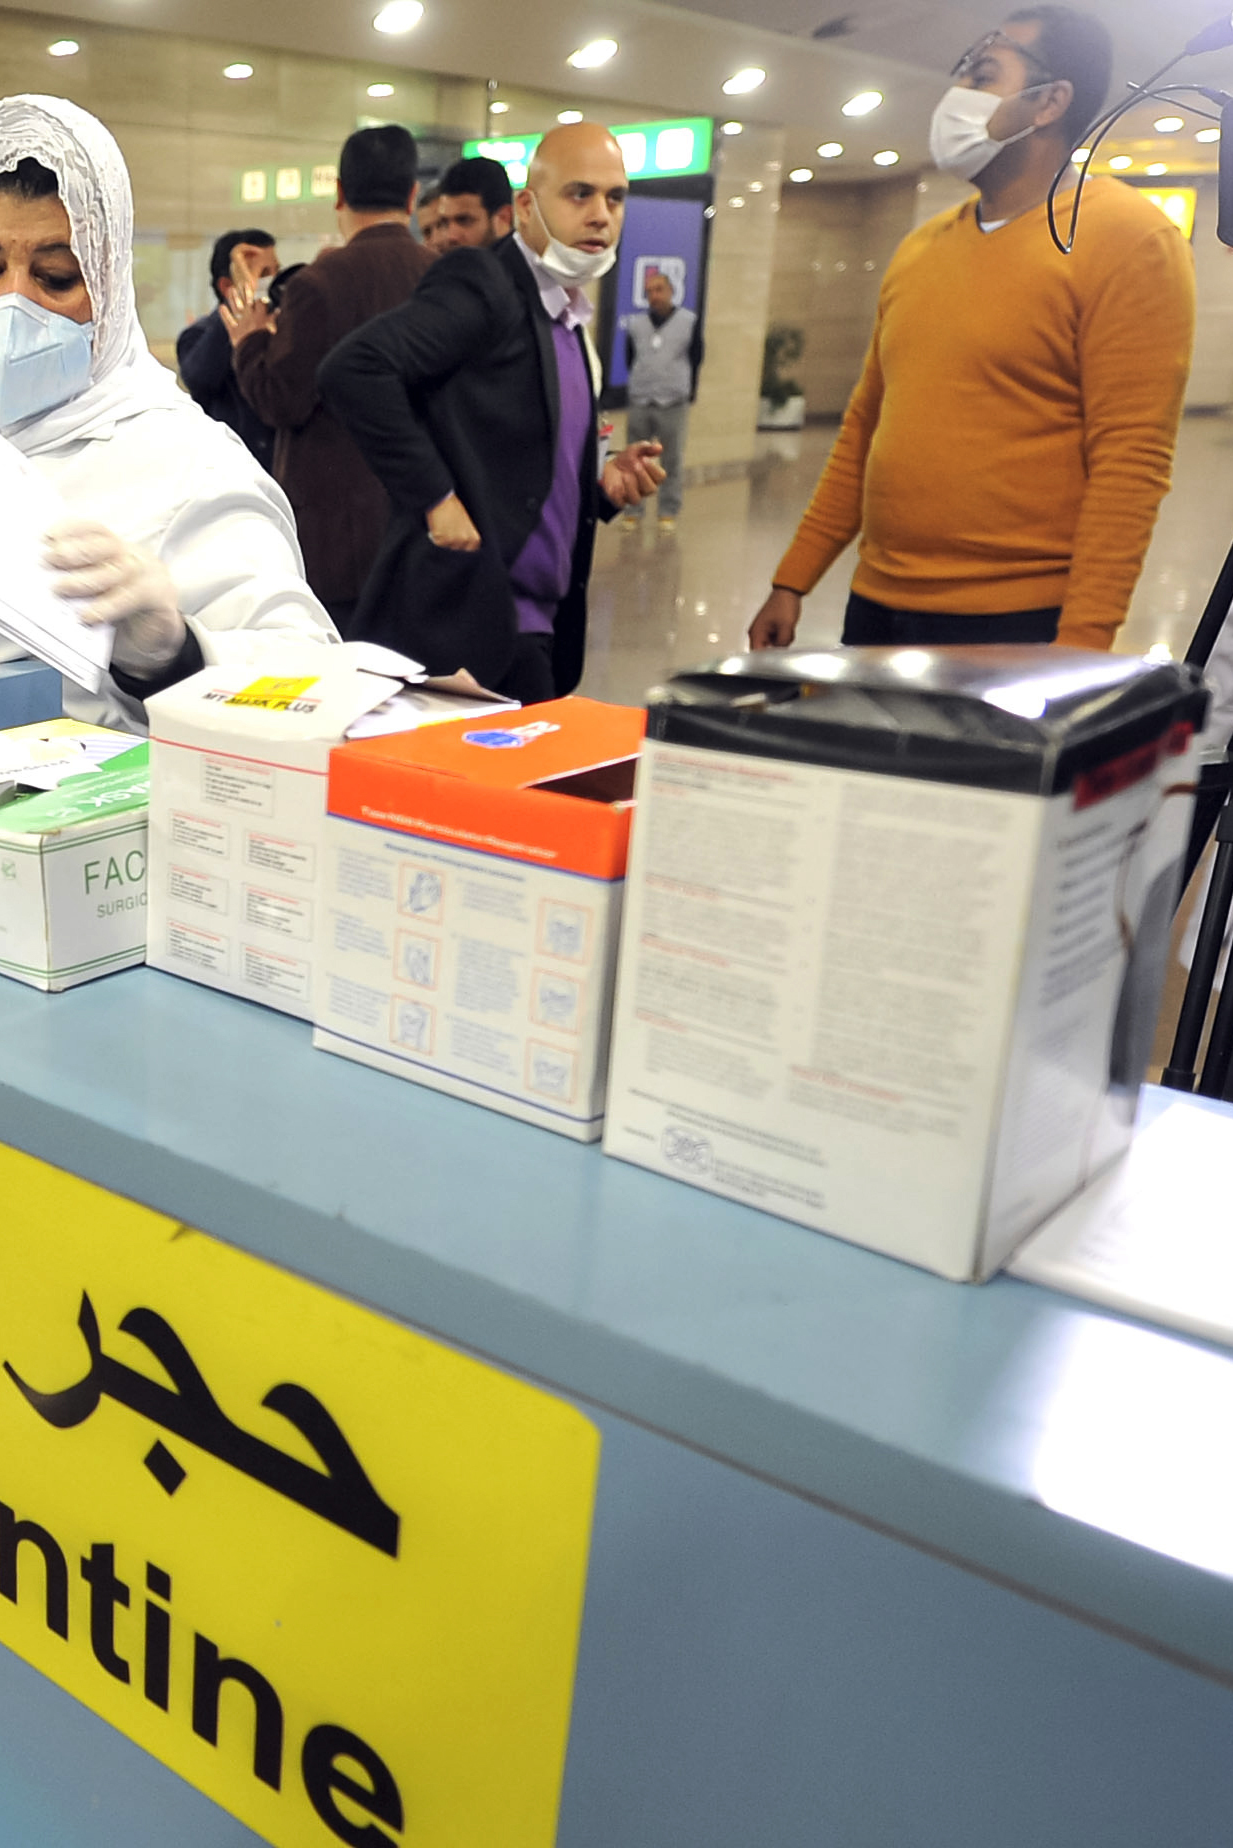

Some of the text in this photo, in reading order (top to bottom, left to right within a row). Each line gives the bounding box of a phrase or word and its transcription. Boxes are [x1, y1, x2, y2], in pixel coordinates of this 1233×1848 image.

[273, 700, 318, 713] PLUS
[84, 850, 146, 895] FAC
[3, 1288, 401, 1560] حجر
